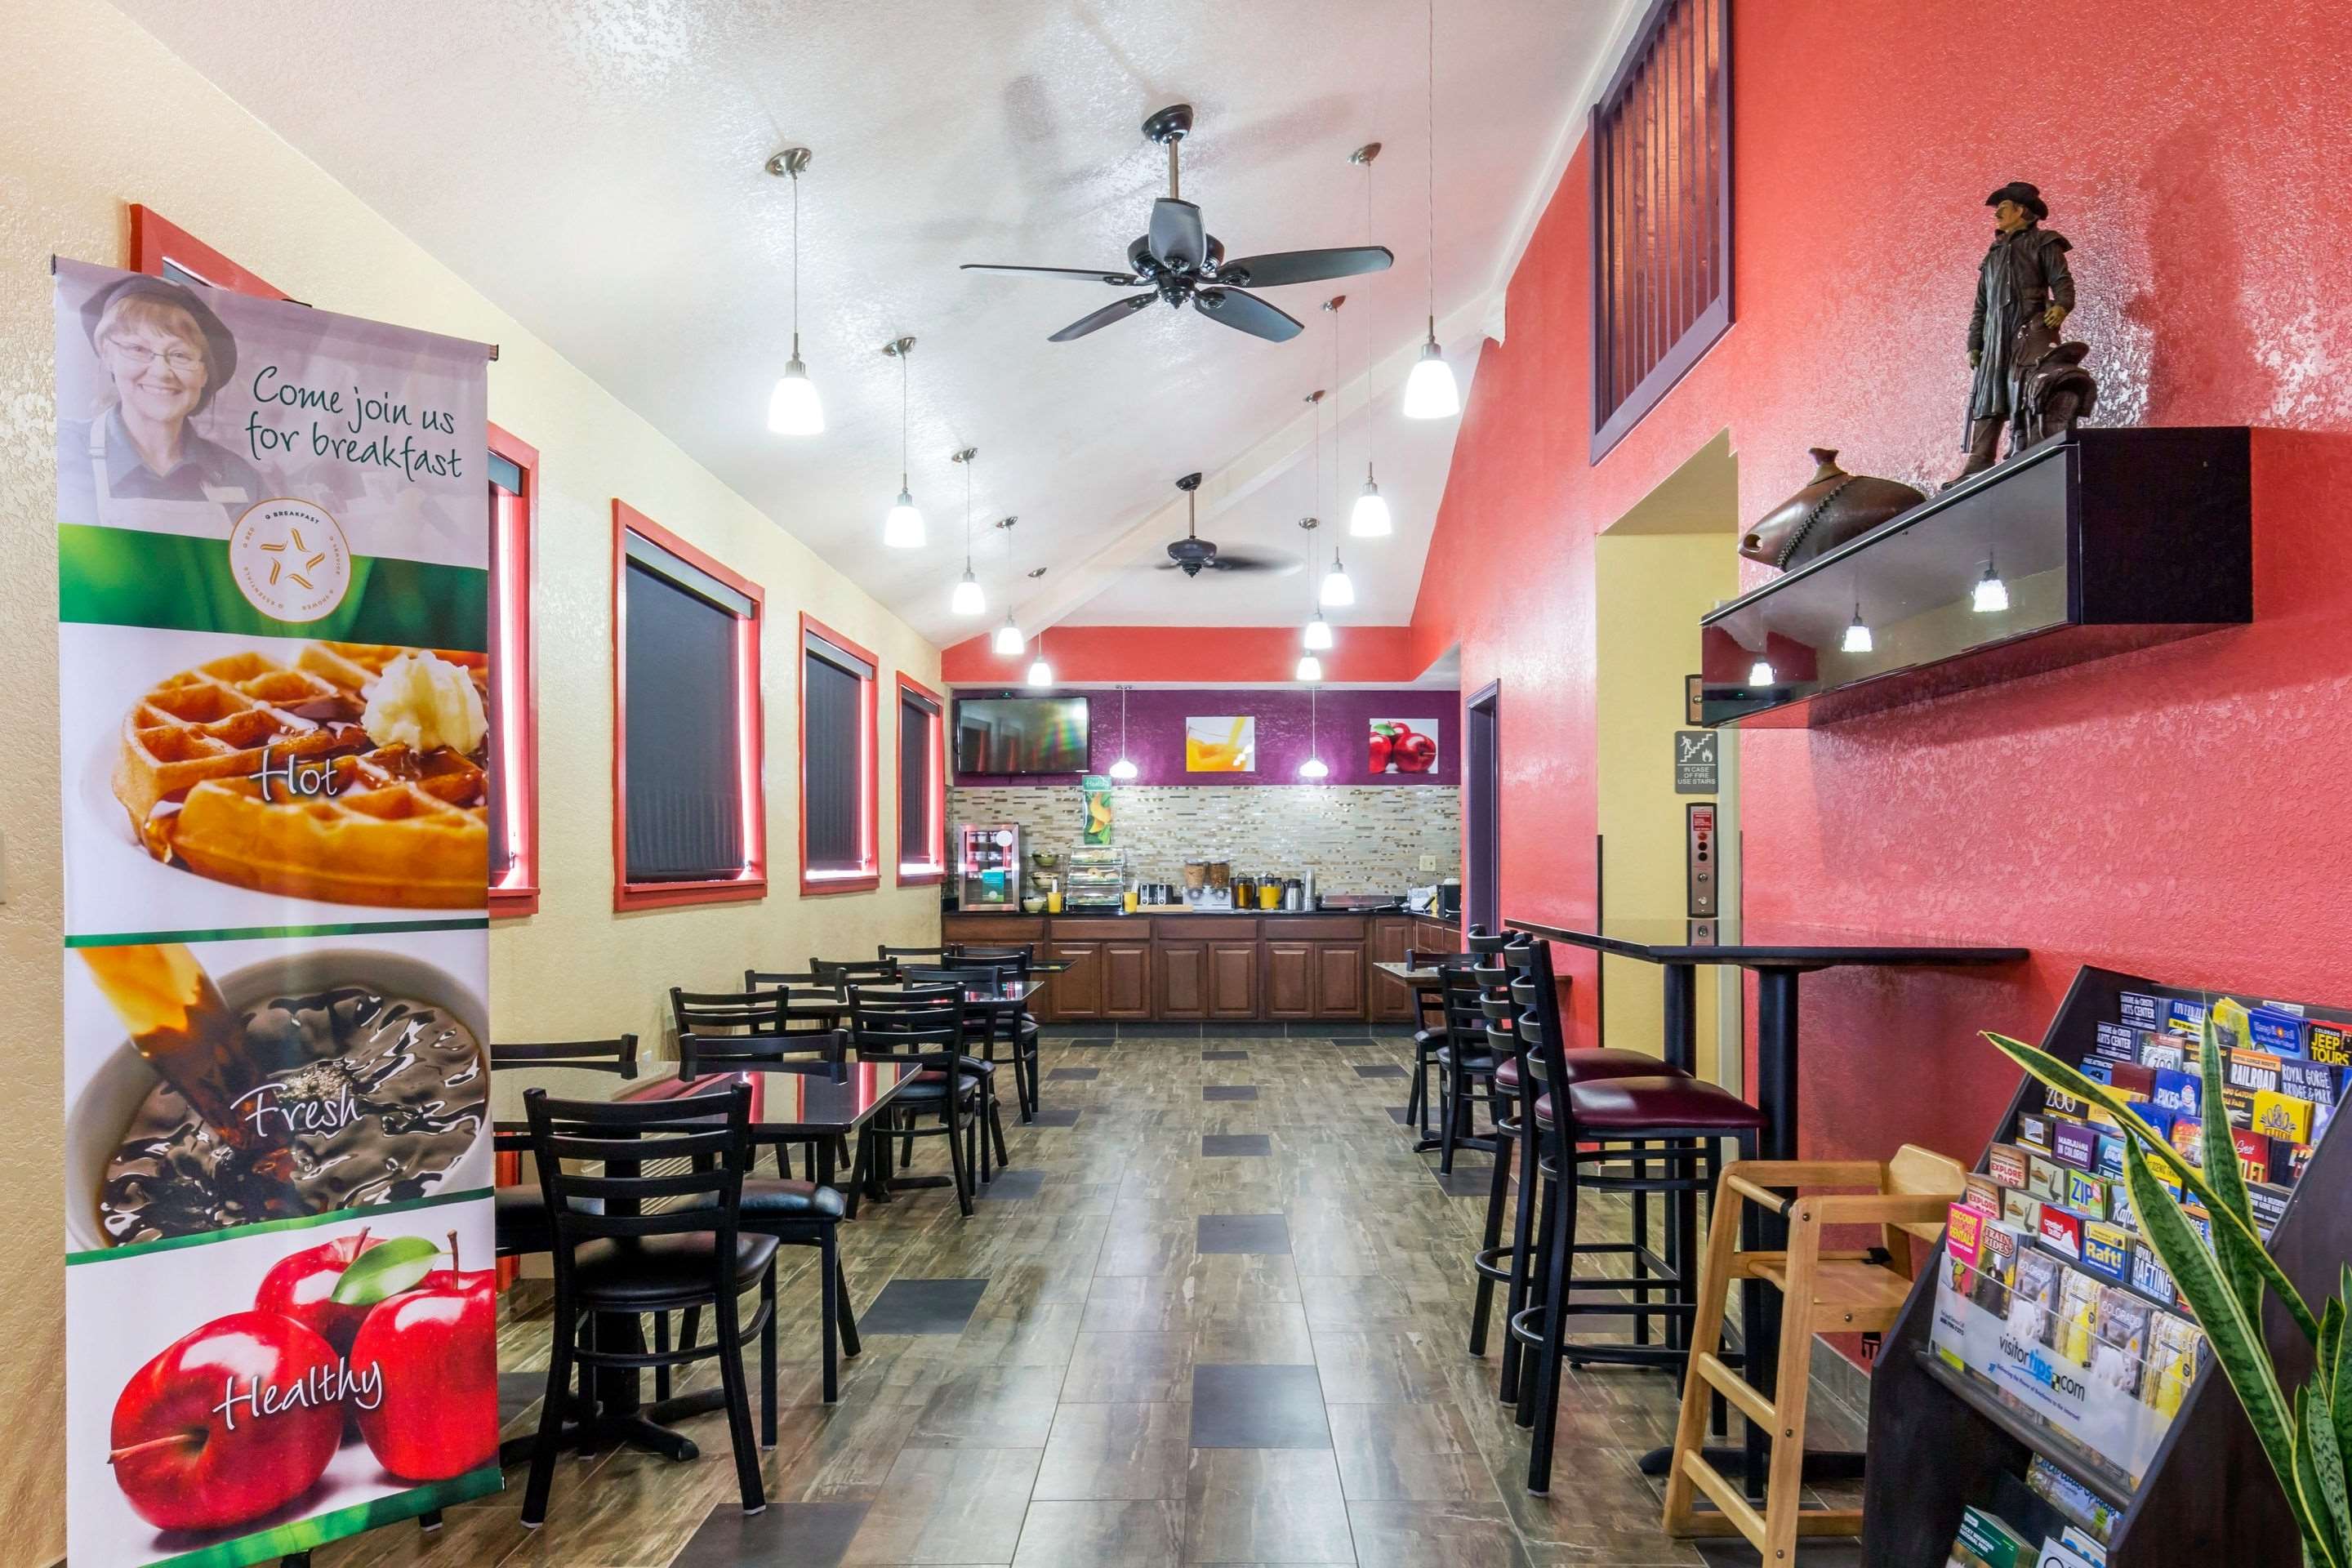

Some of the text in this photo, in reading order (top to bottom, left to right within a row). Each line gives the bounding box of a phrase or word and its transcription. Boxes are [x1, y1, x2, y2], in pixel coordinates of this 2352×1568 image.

[253, 366, 454, 434] Come join us
[245, 411, 462, 482] for breakfast
[273, 510, 320, 524] BREAKFAST
[248, 748, 338, 802] Hot
[2121, 1003, 2155, 1019] ARTS CENTER
[2097, 1032, 2132, 1050] ARTS CENTER
[2311, 1032, 2341, 1051] JEEP
[2314, 1027, 2341, 1038] COLORADO
[2311, 1046, 2350, 1066] TOURS
[2230, 1063, 2276, 1091] RAILROAD
[2282, 1064, 2329, 1089] ROYAL GORGE
[2045, 1085, 2076, 1113] ZOO
[2158, 1088, 2180, 1110] PIKES
[2282, 1081, 2306, 1100] BRIDGE
[2314, 1089, 2332, 1105] PARK
[229, 1083, 365, 1138] Fresh
[2057, 1136, 2089, 1152] MARIJUANA
[2057, 1144, 2064, 1154] IN
[2064, 1146, 2089, 1163] COLORADO
[1991, 1163, 2023, 1180] EXPLORE
[2071, 1176, 2094, 1206] ZIP
[1968, 1193, 1998, 1212] EXPLORE
[1949, 1226, 1975, 1247] RENTALS
[1984, 1227, 2011, 1245] TRAIN
[1984, 1236, 2010, 1256] RIDES
[2085, 1241, 2123, 1269] Raft!
[2132, 1256, 2172, 1297] RAFTING
[2102, 1300, 2142, 1330] COLORADO
[212, 1356, 382, 1430] Healthy
